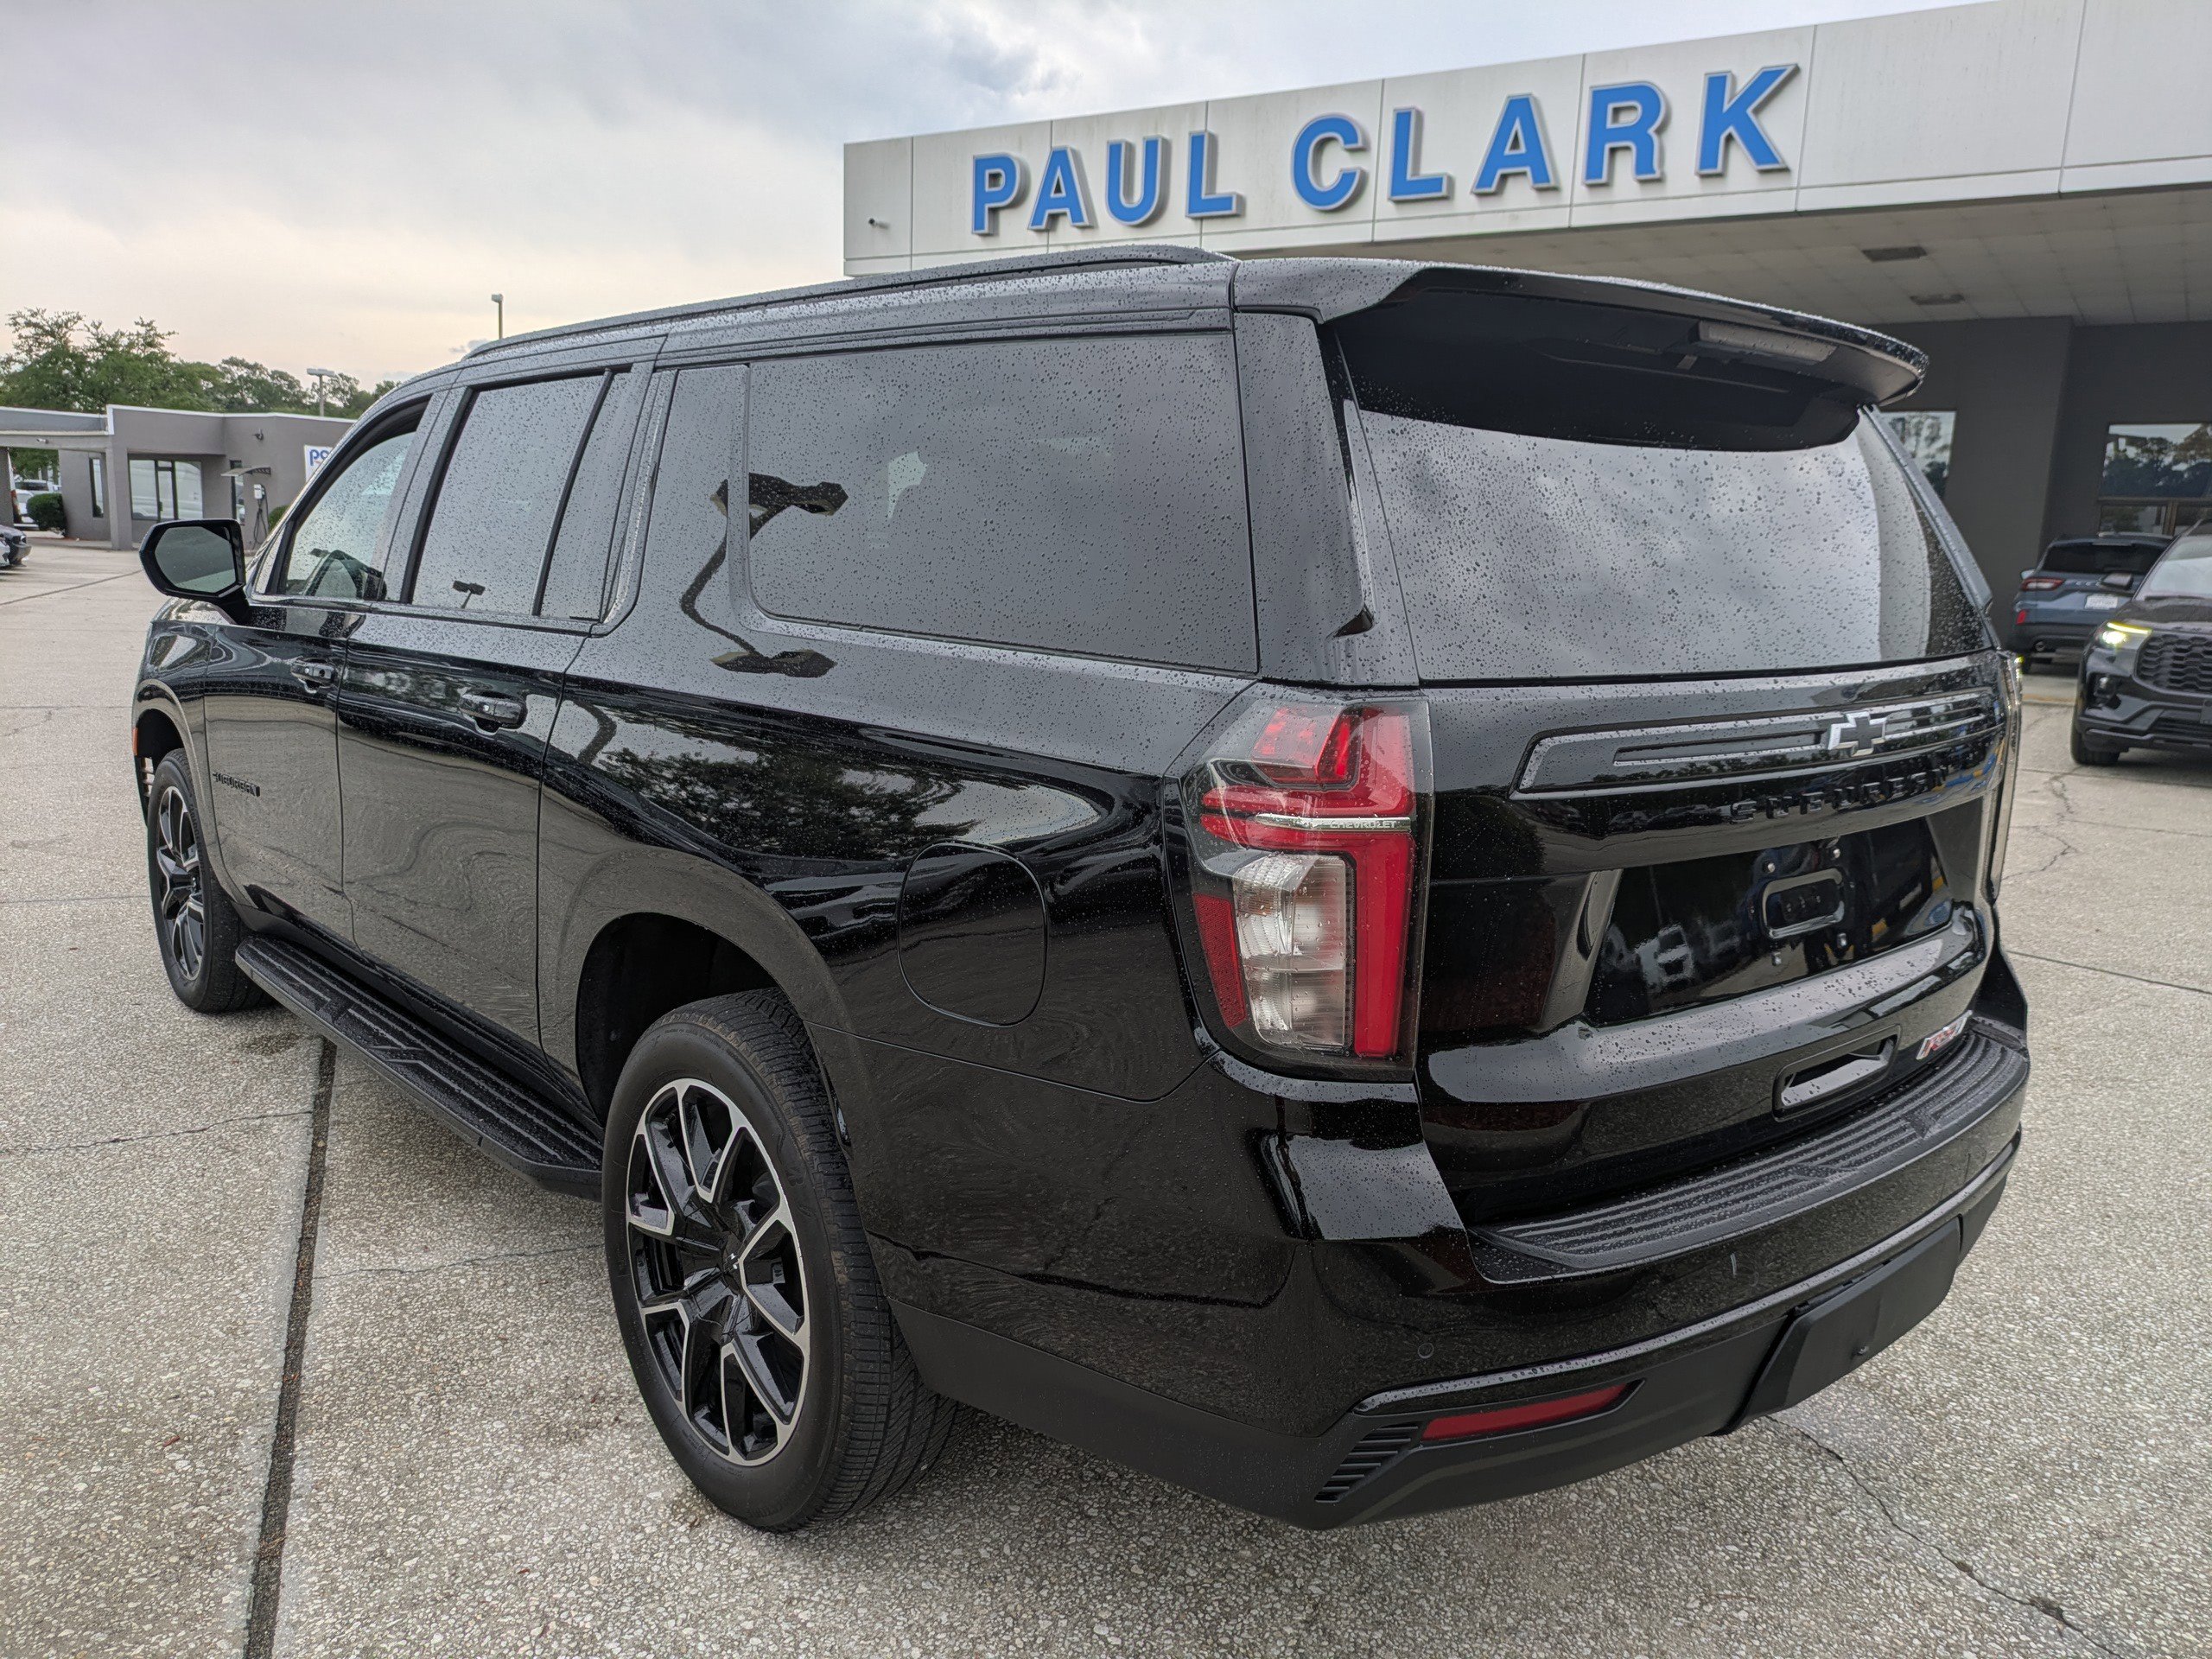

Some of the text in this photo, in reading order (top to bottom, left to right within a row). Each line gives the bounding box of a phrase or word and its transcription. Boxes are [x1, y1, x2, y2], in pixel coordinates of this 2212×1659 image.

[971, 63, 1800, 235] PAUL CLARK
[1330, 820, 1397, 829] CHEVROLET
